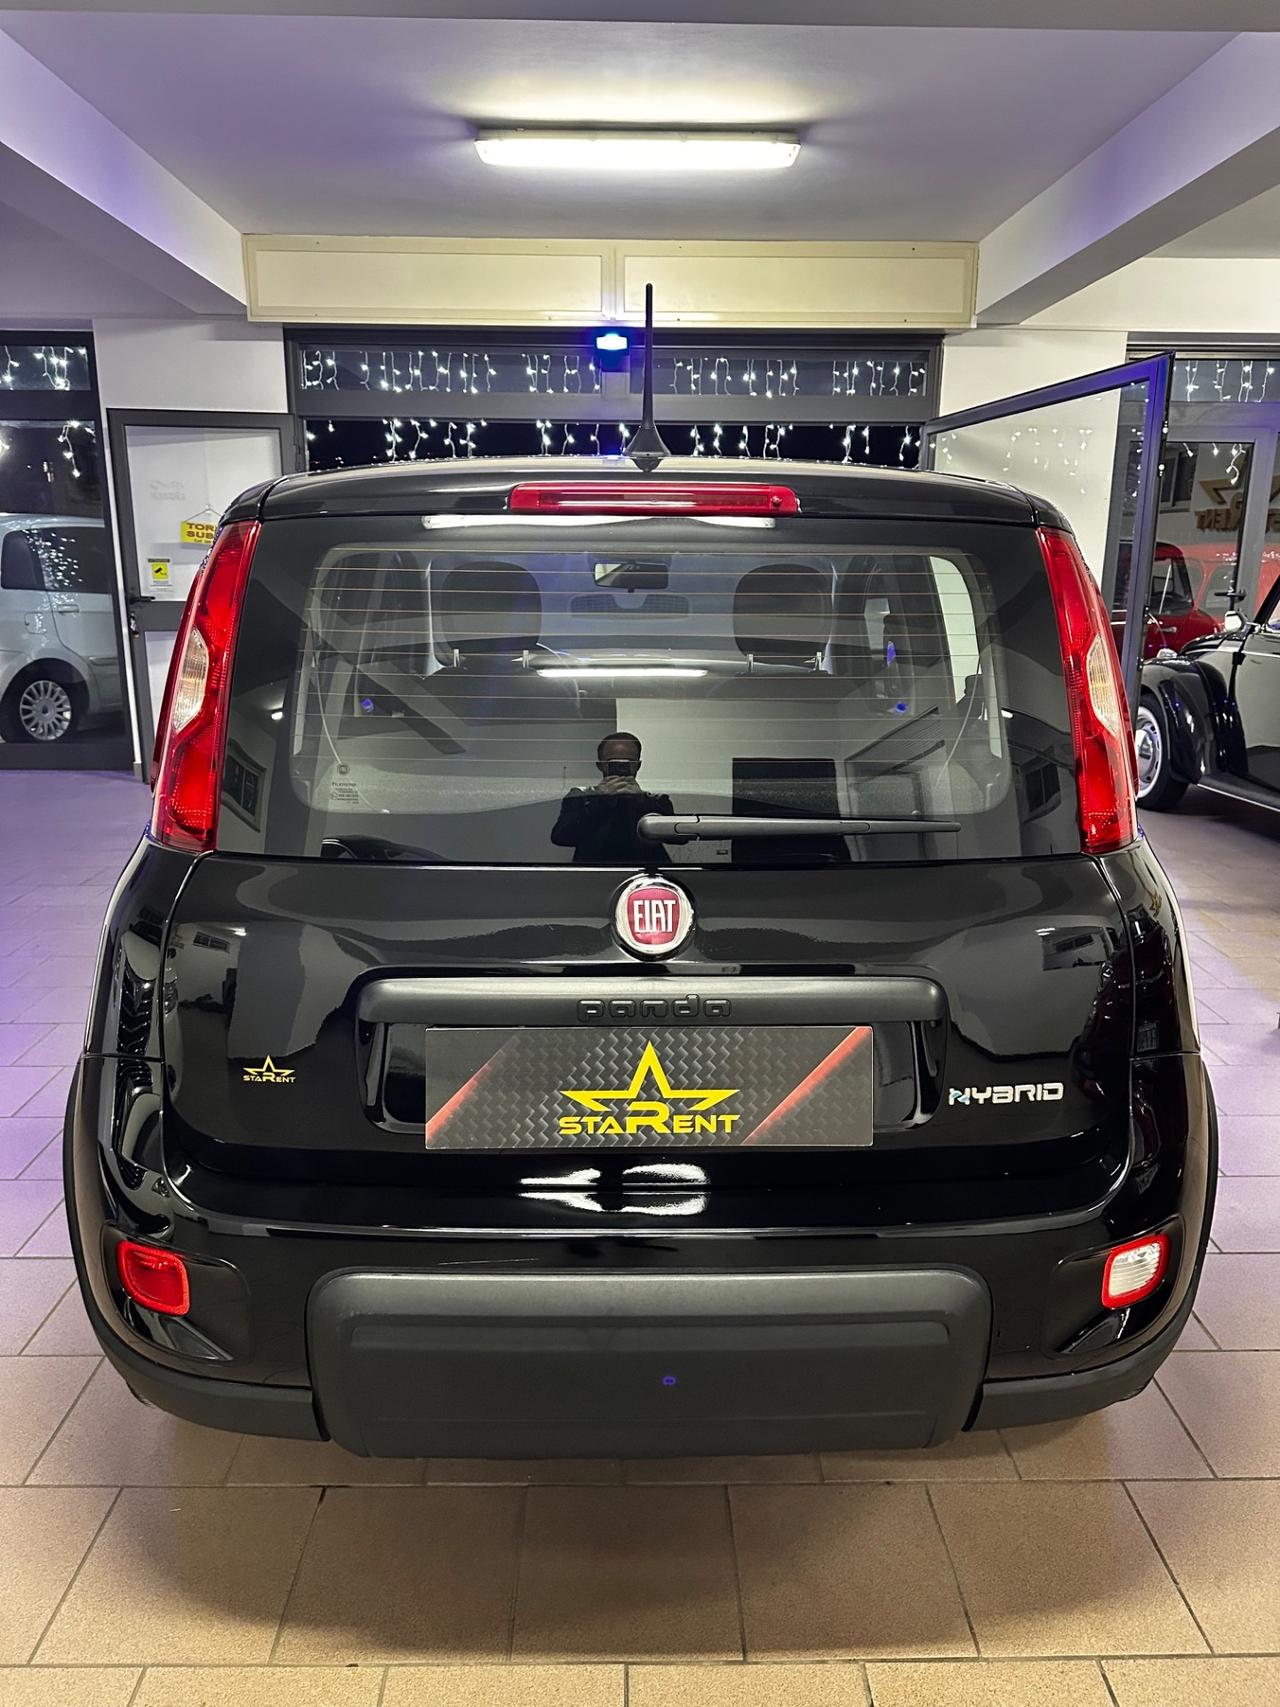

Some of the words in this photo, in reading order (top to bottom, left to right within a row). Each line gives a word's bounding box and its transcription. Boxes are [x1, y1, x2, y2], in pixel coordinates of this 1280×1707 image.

[633, 899, 676, 933] FIAT
[948, 1082, 1064, 1105] HYBRID
[558, 1101, 741, 1135] STARENT
